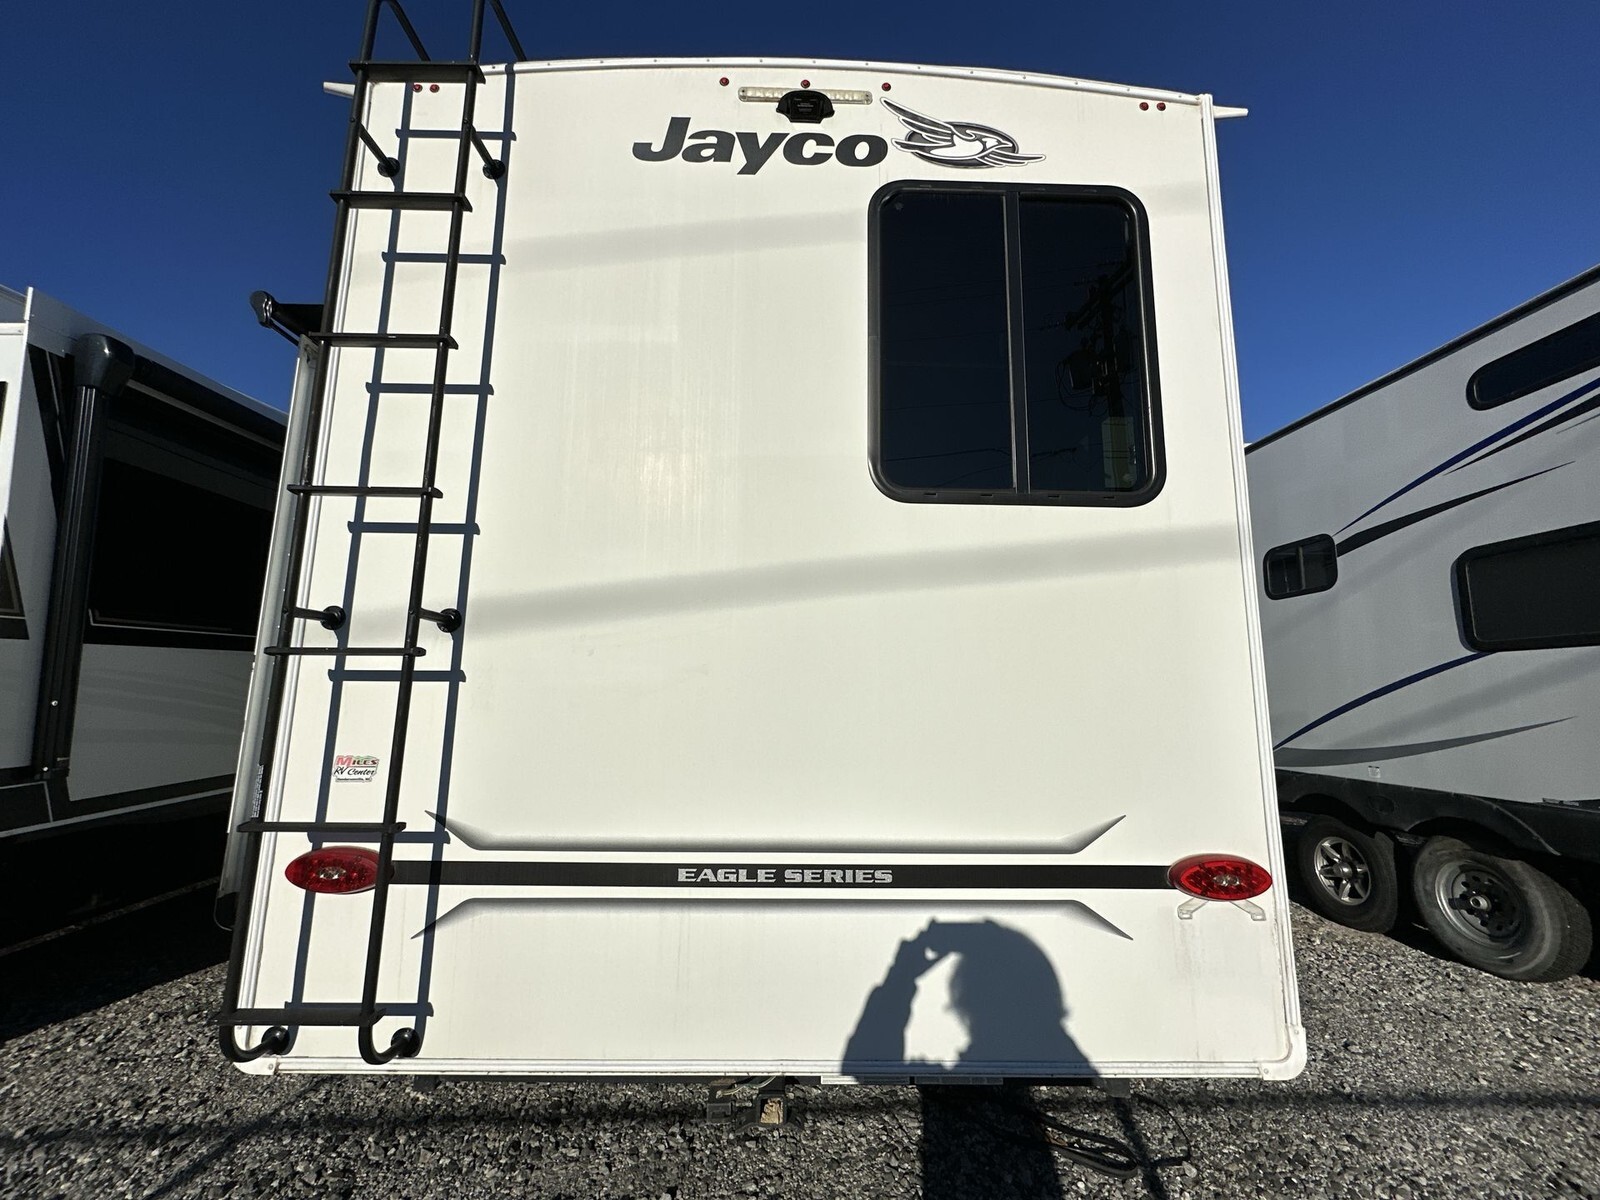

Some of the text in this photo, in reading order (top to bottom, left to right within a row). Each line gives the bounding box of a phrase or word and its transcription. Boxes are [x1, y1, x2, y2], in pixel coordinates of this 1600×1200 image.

[632, 116, 889, 176] Jayco
[333, 766, 376, 776] RV Center
[677, 868, 893, 884] EAGLE SERIES
